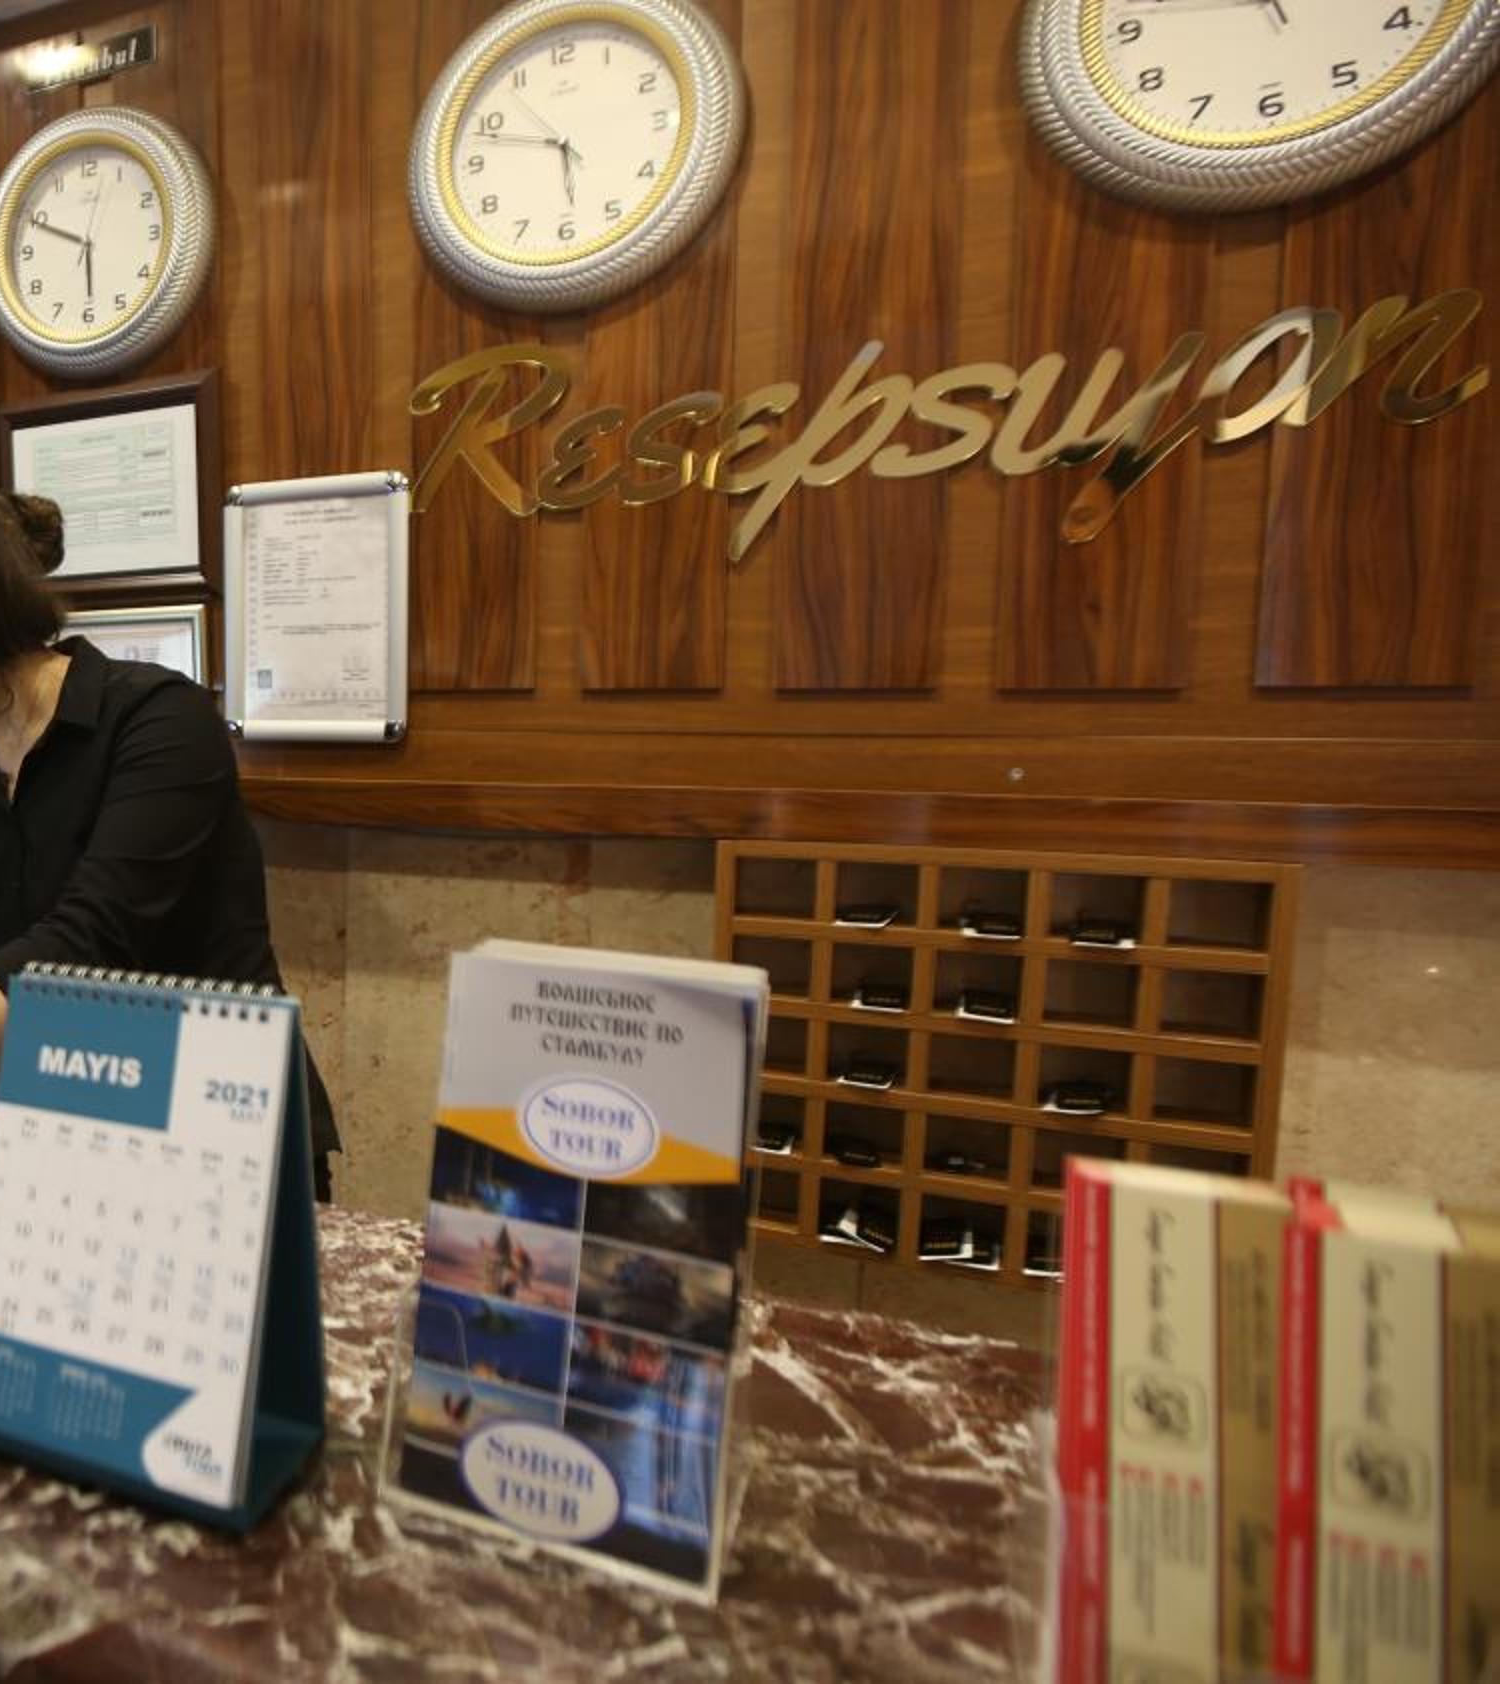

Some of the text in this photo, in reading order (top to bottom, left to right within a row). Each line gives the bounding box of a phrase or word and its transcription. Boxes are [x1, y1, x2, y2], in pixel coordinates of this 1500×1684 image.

[1383, 7, 1413, 31] 4
[1117, 19, 1142, 43] 9
[550, 42, 576, 65] 12
[512, 69, 527, 89] 11
[638, 72, 656, 93] 2
[1139, 67, 1164, 91] 8
[1330, 60, 1358, 88] 5
[1188, 94, 1214, 121] 7
[1258, 92, 1284, 118] 6
[480, 111, 504, 135] 10
[653, 111, 670, 132] 3
[81, 160, 98, 177] 12
[468, 155, 485, 173] 9
[637, 160, 655, 178] 4
[141, 191, 153, 208] 2
[481, 195, 498, 215] 8
[604, 200, 621, 221] 5
[148, 224, 160, 240] 3
[513, 219, 529, 244] 7
[558, 222, 576, 240] 6
[22, 246, 34, 260] 9
[138, 264, 149, 279] 4
[31, 280, 42, 295] 8
[51, 303, 64, 323] 7
[115, 294, 127, 311] 5
[83, 308, 95, 323] 6
[656, 1022, 685, 1044] ПО
[38, 1045, 142, 1088] MAYIS
[204, 1079, 269, 1108] 2021
[550, 1127, 621, 1160] TOUR
[496, 1477, 580, 1526] TOUR
